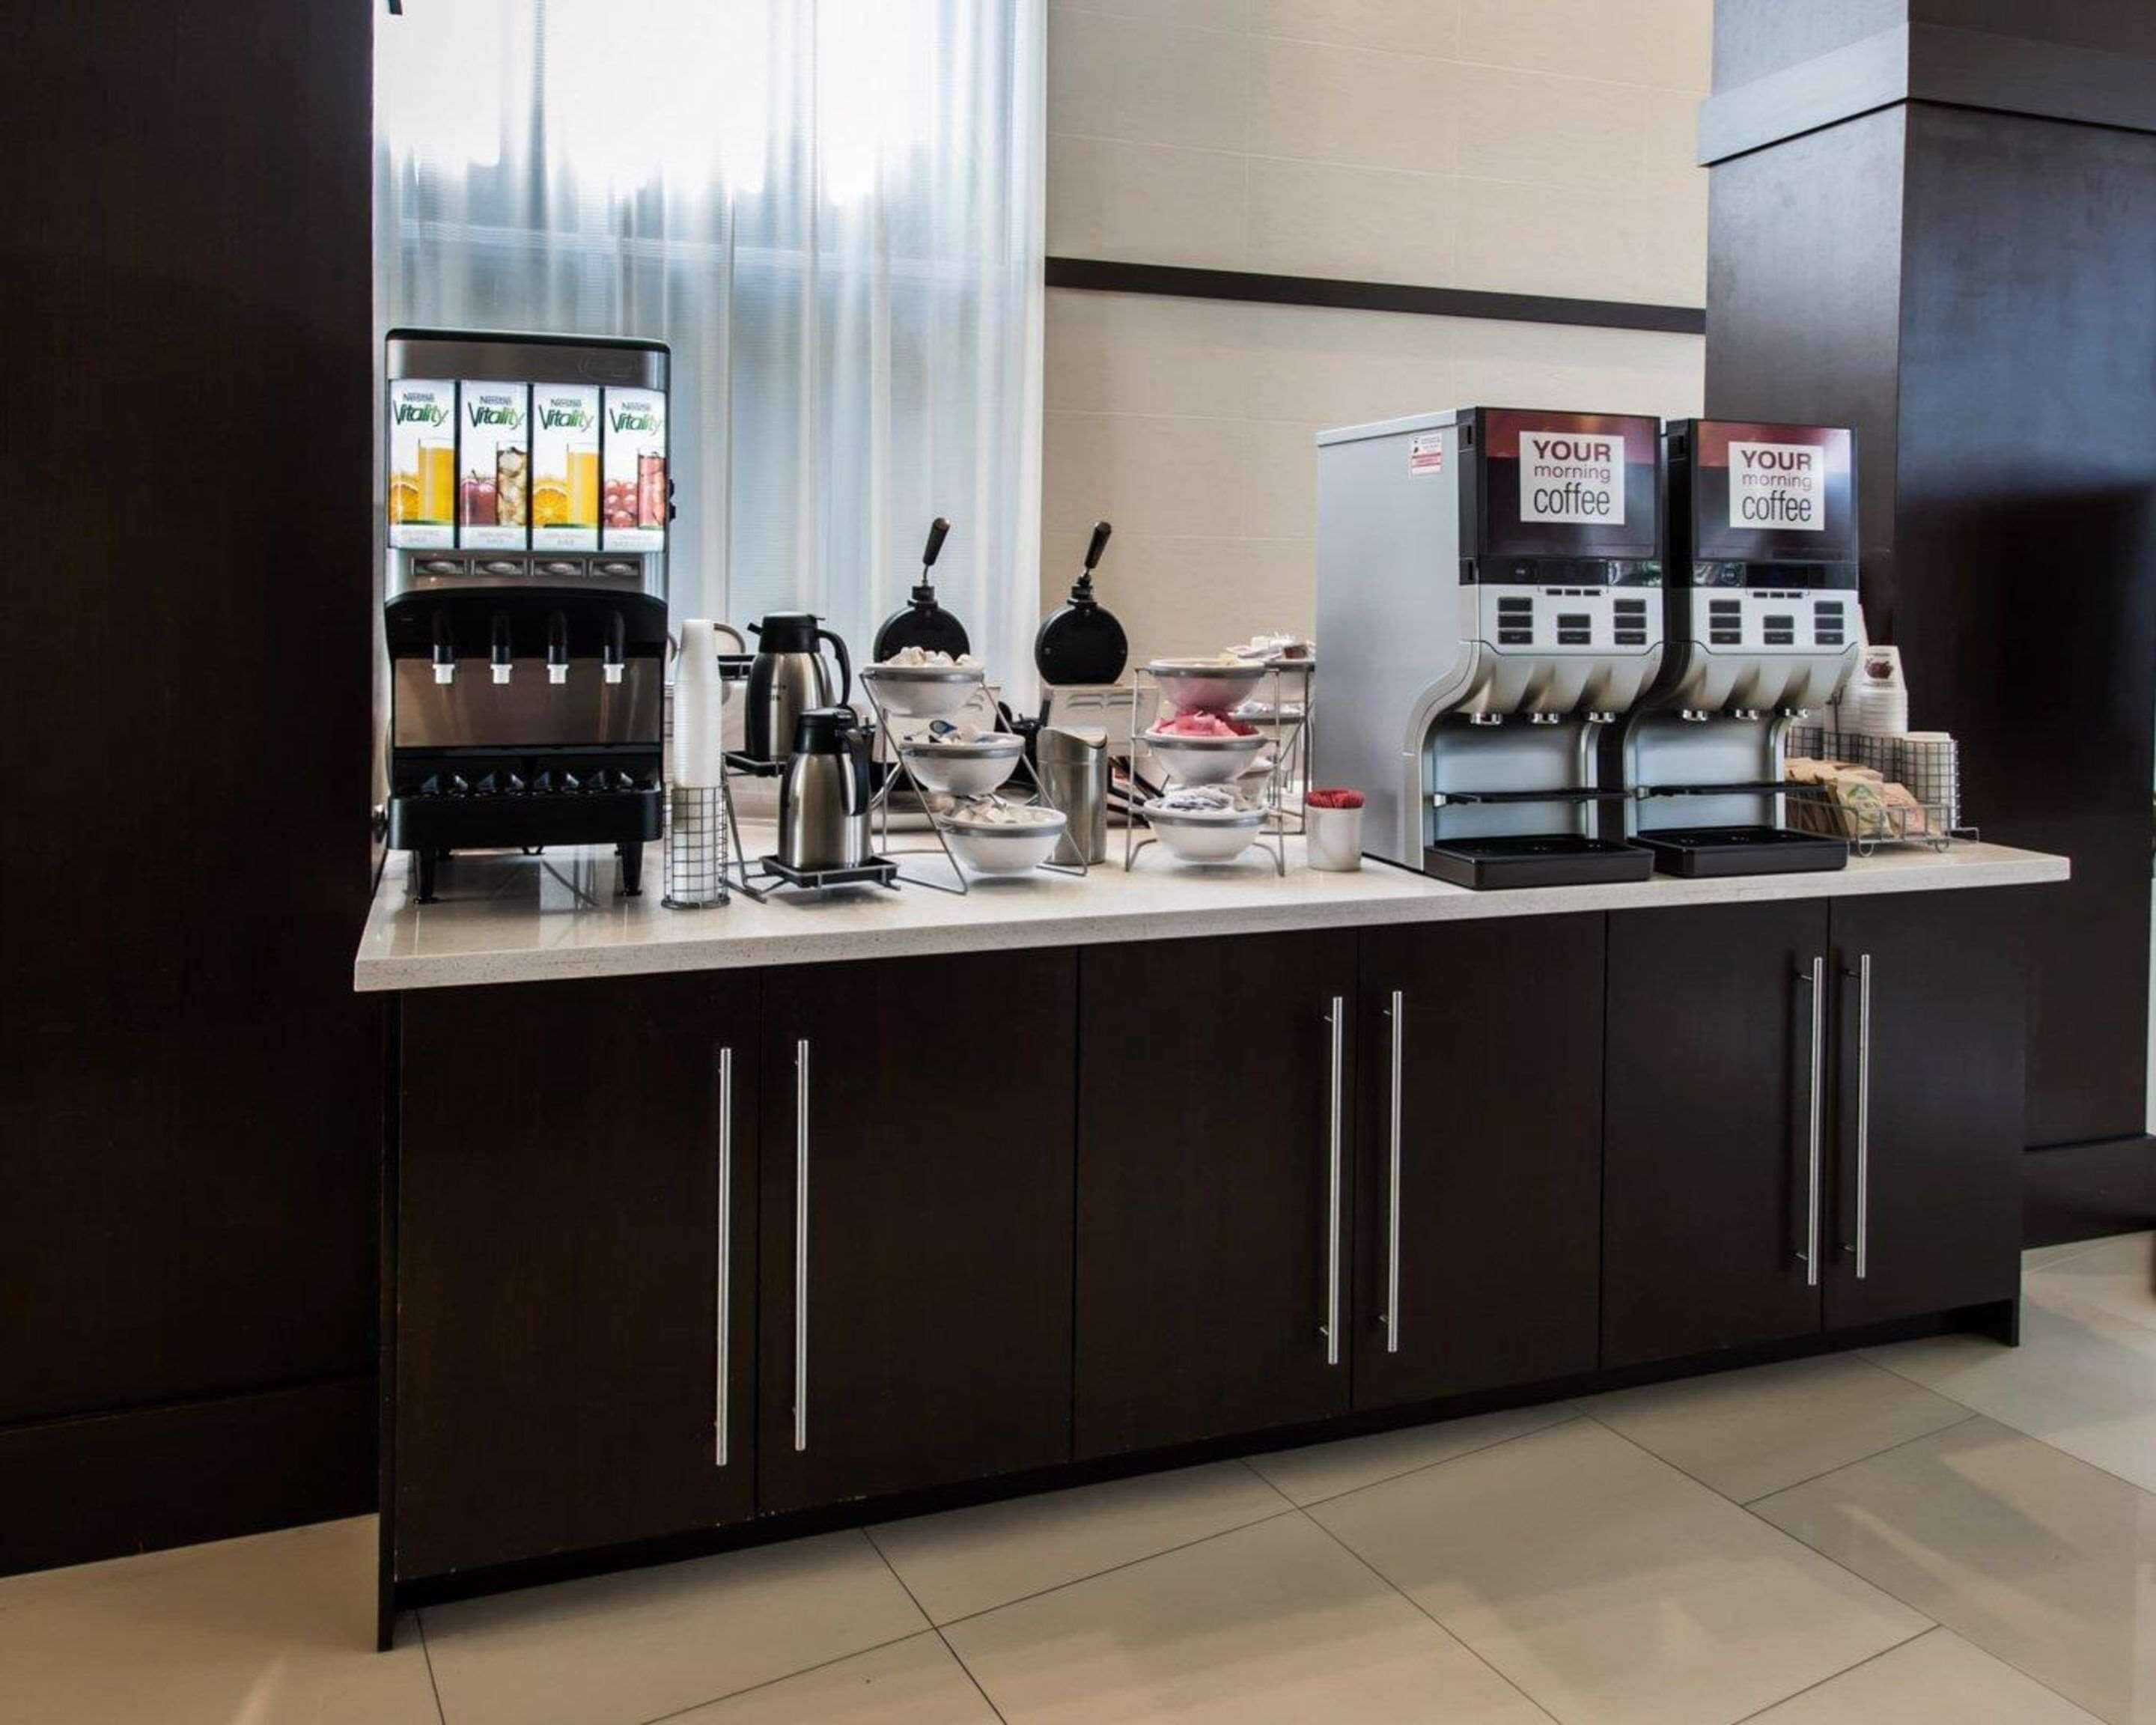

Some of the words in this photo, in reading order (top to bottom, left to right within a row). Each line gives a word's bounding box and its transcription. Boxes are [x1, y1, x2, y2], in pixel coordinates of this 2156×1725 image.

[392, 399, 449, 428] Vitality
[467, 401, 526, 430] Vitality
[538, 404, 594, 433] Vitality
[609, 408, 662, 436] Vitality
[1532, 439, 1611, 463] YOUR
[1741, 449, 1812, 471] YOUR
[1534, 463, 1611, 484] morning
[1742, 472, 1812, 492] morning
[1533, 481, 1610, 516] coffee
[1741, 489, 1812, 523] coffee
